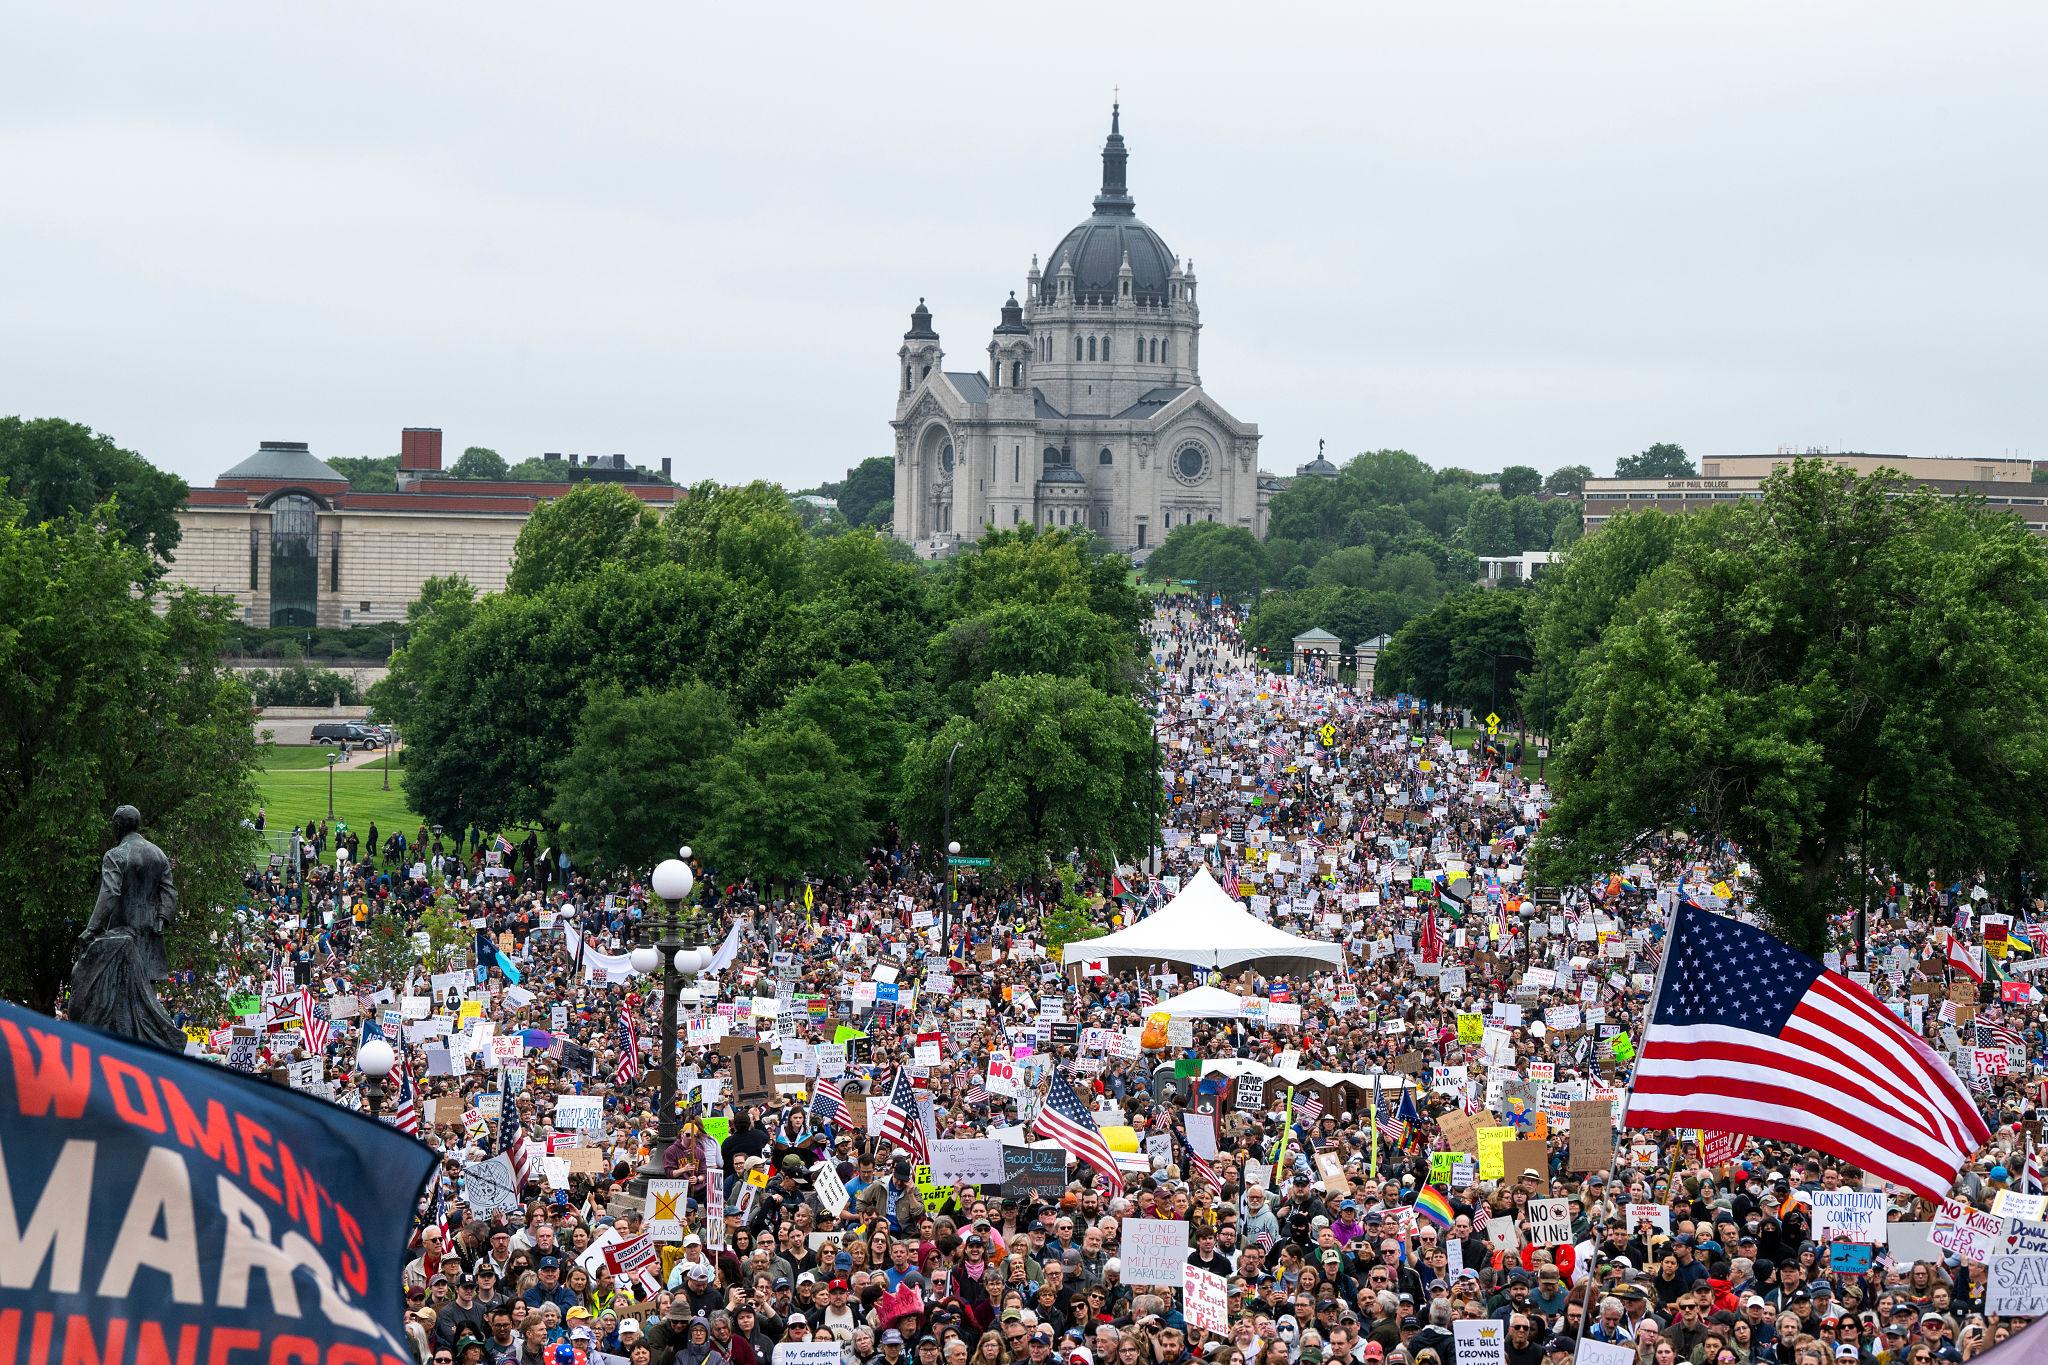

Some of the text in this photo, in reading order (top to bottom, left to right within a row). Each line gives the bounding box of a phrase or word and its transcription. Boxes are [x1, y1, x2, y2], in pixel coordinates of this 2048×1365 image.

[879, 984, 896, 994] Save
[690, 1017, 711, 1030] HATE
[492, 1038, 505, 1046] ARE
[495, 1047, 515, 1055] GREAT
[231, 1053, 252, 1064] OUR
[1974, 1051, 2010, 1066] FUCK
[990, 1062, 1012, 1079] NO
[1436, 1068, 1449, 1076] NO
[1977, 1063, 2009, 1076] ICE
[1436, 1077, 1463, 1086] KINGS
[465, 1110, 476, 1119] NO
[560, 1108, 601, 1118] PROFIT OVER
[578, 1118, 585, 1126] IS
[1479, 1128, 1513, 1139] STAND UP
[932, 1142, 964, 1155] Walking
[0, 1018, 368, 1297] WOMEN'S
[1003, 1151, 1033, 1164] Good
[1434, 1155, 1443, 1165] NO
[651, 1180, 687, 1189] PARASITE
[1813, 1192, 1881, 1210] CONSTITUTION
[1531, 1204, 1548, 1222] NO
[1827, 1211, 1873, 1223] COUNTRY
[1941, 1200, 2001, 1235] NO KINGS
[1139, 1224, 1176, 1234] FUND
[1837, 1222, 1862, 1232] OVER
[2011, 1218, 2048, 1239] DONAL
[1534, 1224, 1568, 1243] KING
[1833, 1229, 1868, 1242] PARTY
[1956, 1226, 1975, 1244] YES
[827, 1236, 839, 1244] NO
[1132, 1234, 1181, 1246] SCIENCE
[1933, 1230, 1985, 1262] QUEENS
[617, 1238, 648, 1260] DISSENT IS
[1137, 1245, 1169, 1257] NOT
[624, 1249, 651, 1269] PATRIOTIC
[1128, 1257, 1183, 1270] MILITARY
[1129, 1268, 1176, 1280] PARADES
[1186, 1265, 1227, 1293] So Much
[1200, 1282, 1207, 1290] to
[1457, 1337, 1500, 1347] THE "BILL"
[785, 1350, 839, 1359] My Grandfather
[1458, 1349, 1500, 1358] CROWNS
